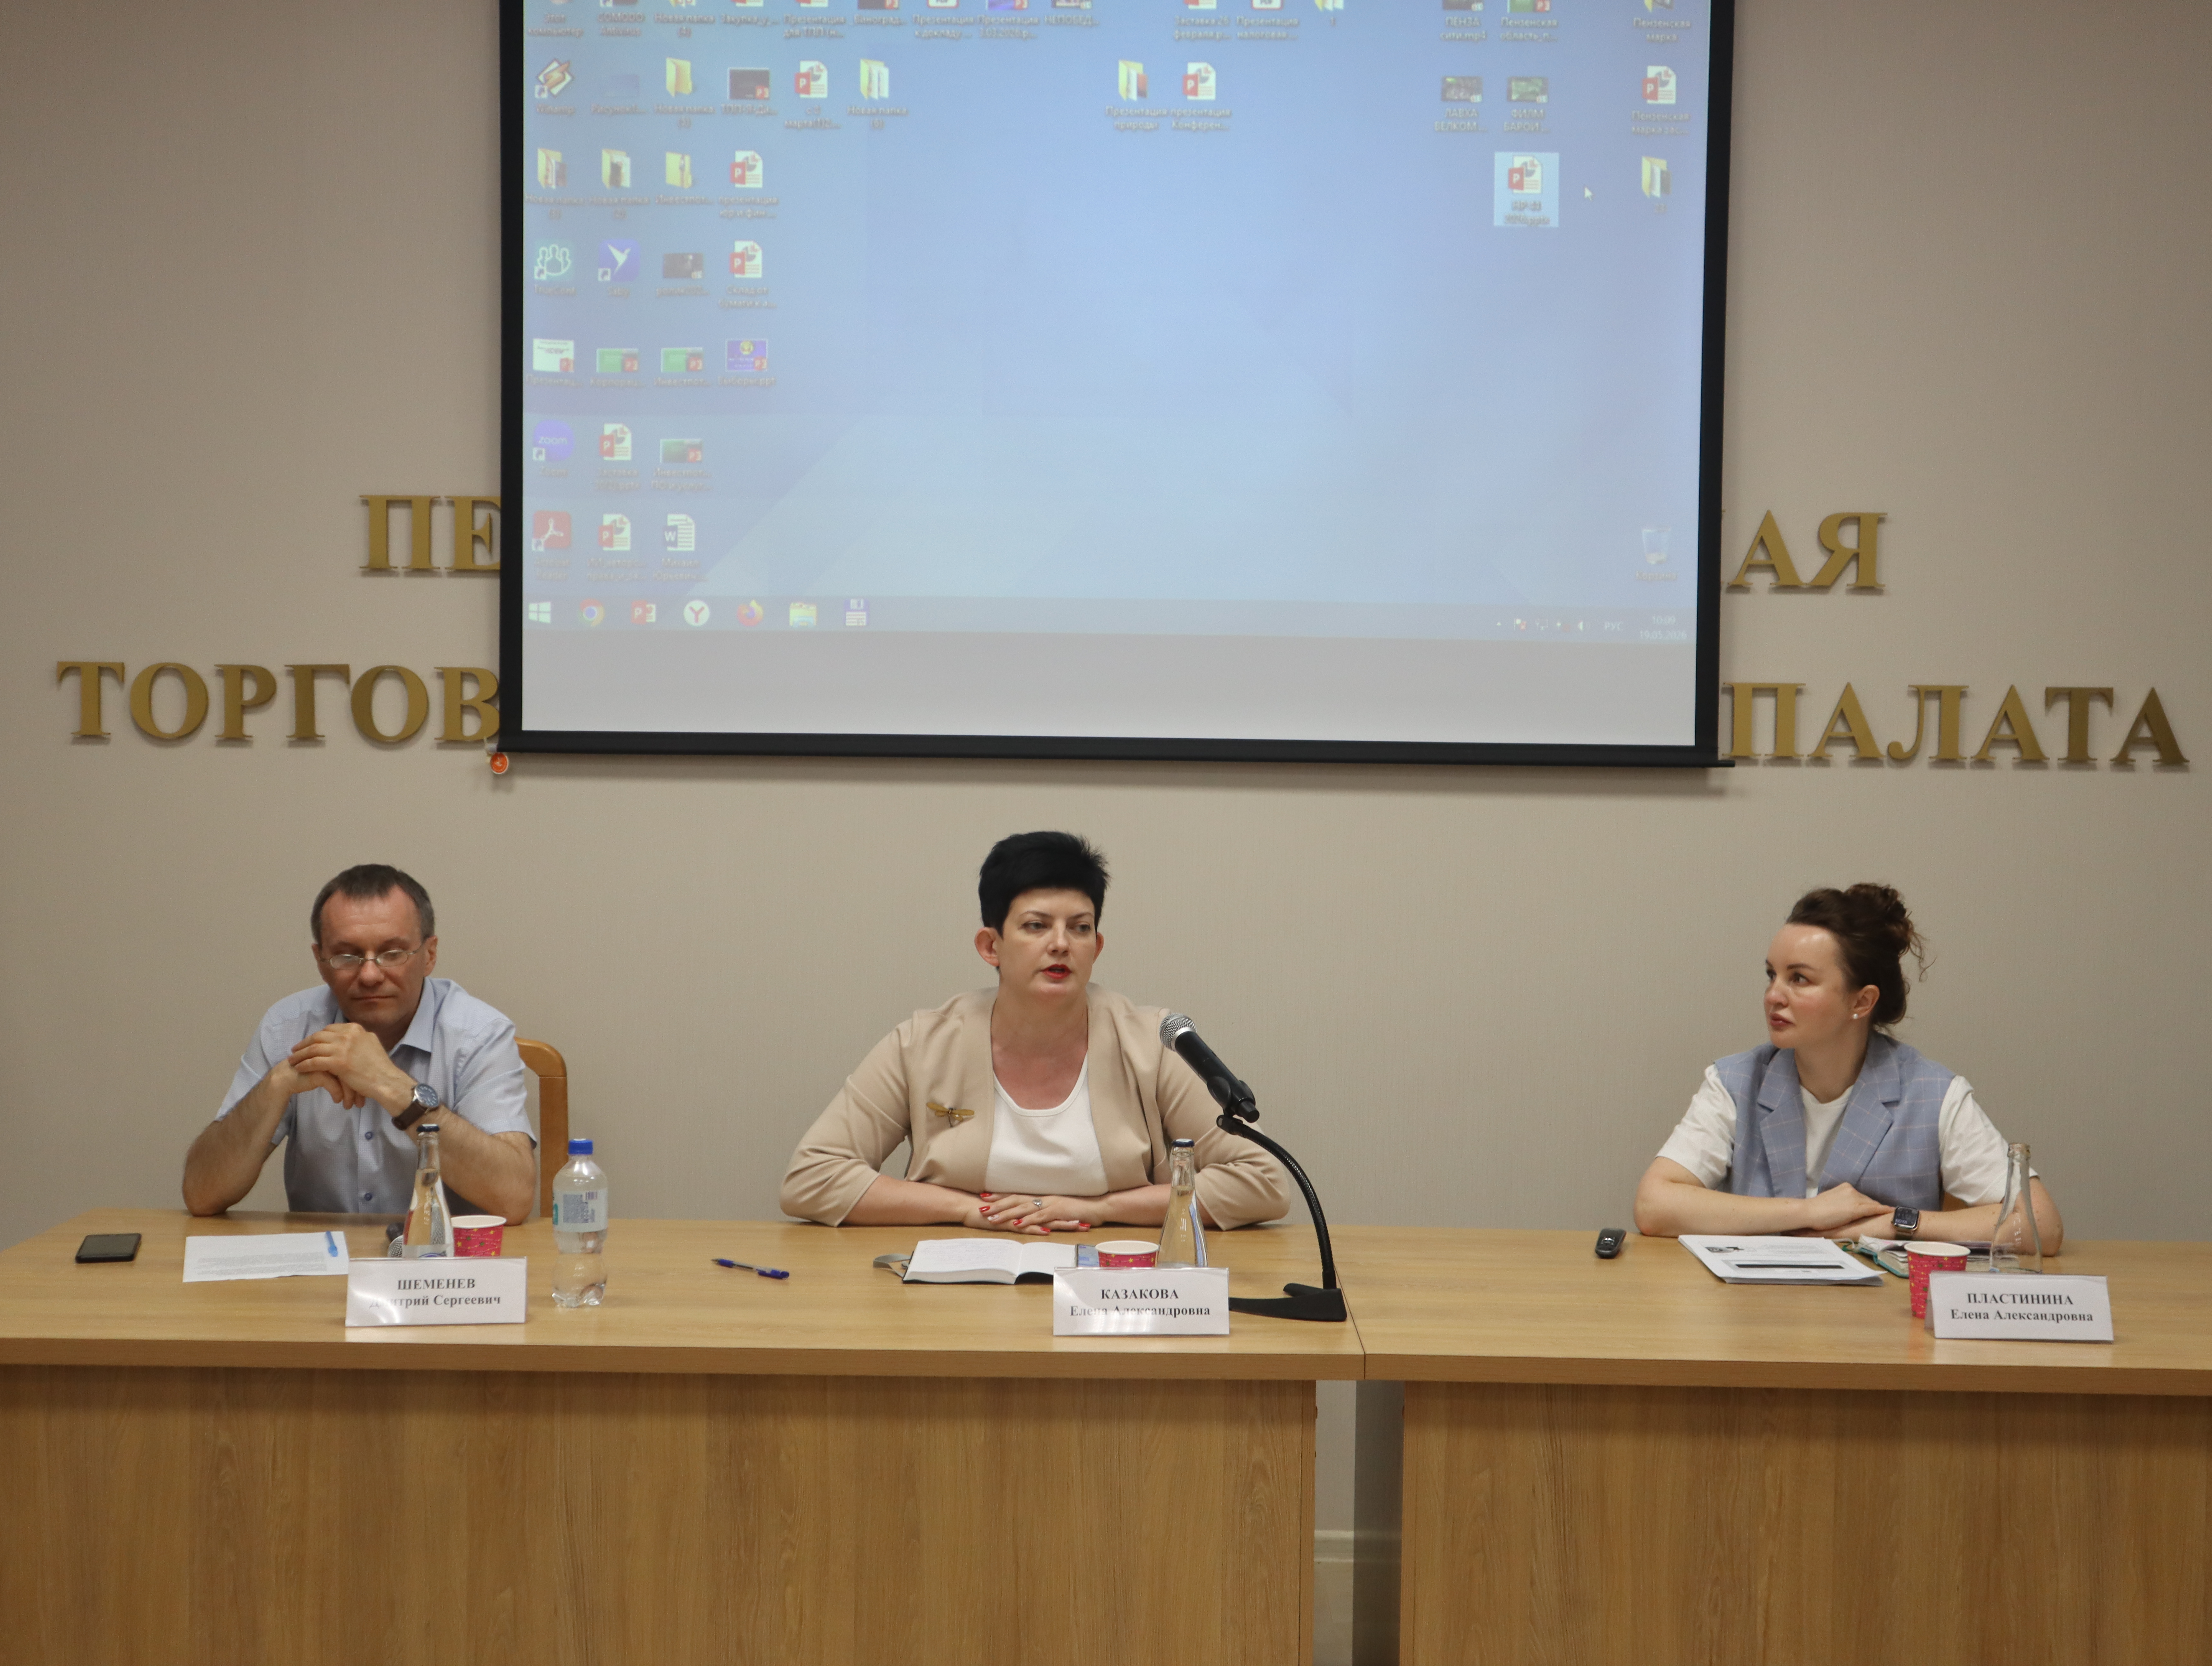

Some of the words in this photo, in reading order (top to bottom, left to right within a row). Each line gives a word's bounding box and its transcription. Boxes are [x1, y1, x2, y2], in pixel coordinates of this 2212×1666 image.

[597, 13, 645, 23] COMODO
[783, 14, 846, 26] Презентация
[912, 15, 974, 27] Презентация
[978, 15, 1040, 27] Презентация
[1236, 17, 1300, 28] Презентация
[1445, 17, 1481, 28] ПЕНЗА
[1501, 17, 1558, 28] Пензенская
[1633, 18, 1691, 29] Пензенская
[1106, 106, 1168, 118] Презентация
[1171, 108, 1232, 118] презентация
[359, 494, 500, 571] ПЕ
[1722, 509, 1887, 589] АЯ
[1604, 621, 1623, 631] РУС
[56, 661, 499, 743] ТОРГОВ
[1722, 682, 2190, 765] ПАЛАТА
[398, 1278, 476, 1290] ШЕМЕНЕВ
[1101, 1288, 1179, 1300] КАЗАКОВА
[1967, 1293, 2073, 1305] ПЛАСТИНИНА
[370, 1296, 429, 1309] Дитрий
[433, 1294, 501, 1308] Сергеевич
[1070, 1306, 1108, 1316] Елена
[1113, 1305, 1210, 1318] Александровна
[1951, 1309, 1989, 1320] Елена
[1994, 1310, 2093, 1323] Александровна
